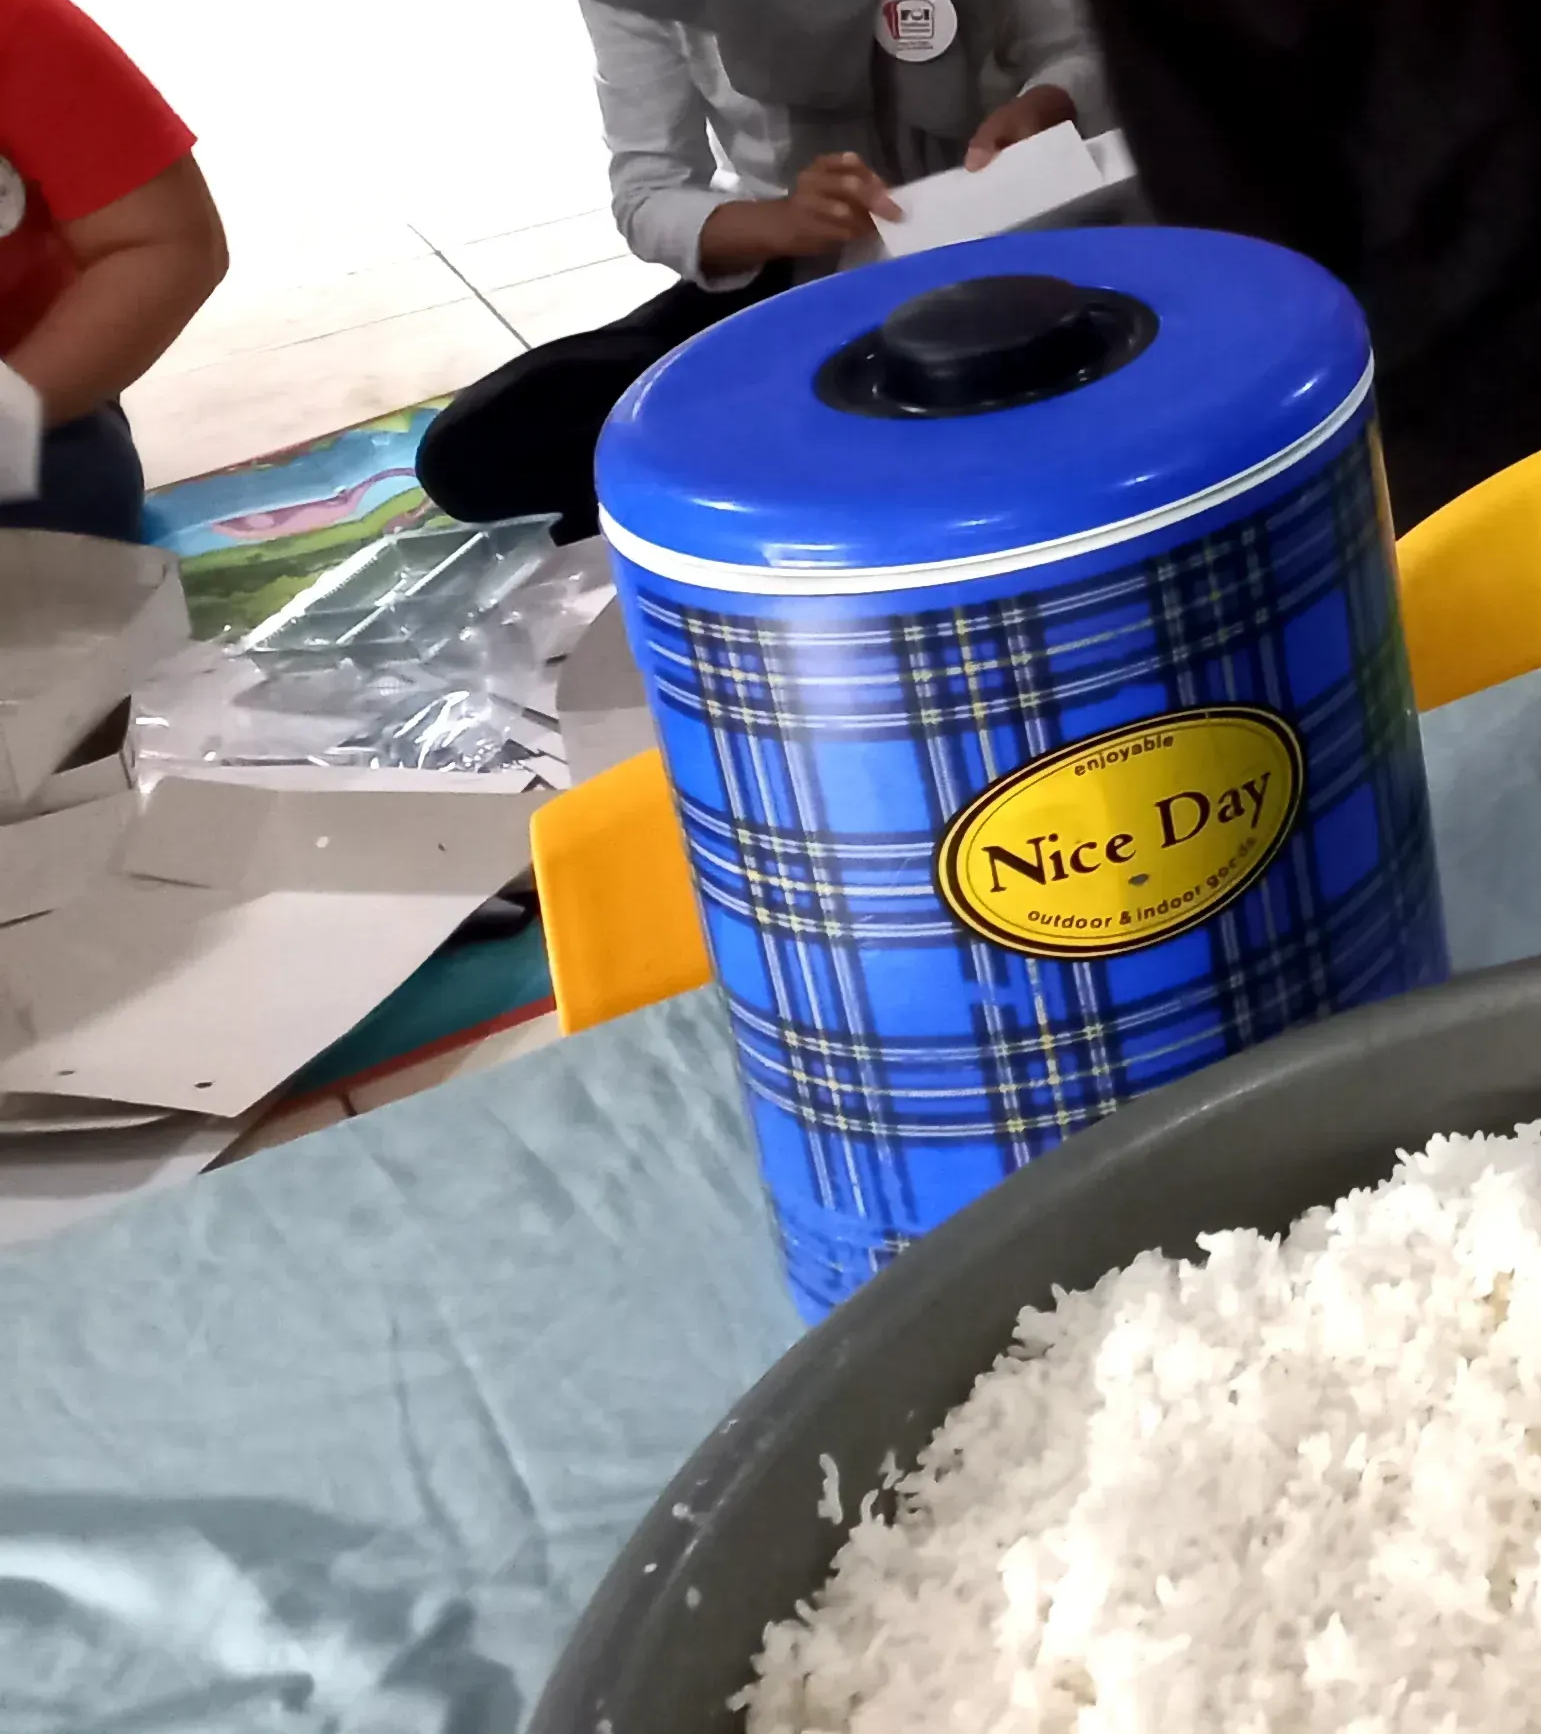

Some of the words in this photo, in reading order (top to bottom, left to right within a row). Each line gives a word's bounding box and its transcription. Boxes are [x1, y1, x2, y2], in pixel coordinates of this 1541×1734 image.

[1074, 734, 1174, 777] enjoyable
[982, 832, 1138, 894] Nice
[1154, 772, 1272, 850] Day
[1027, 910, 1112, 930] outdoor
[1119, 911, 1132, 926] &
[1136, 884, 1202, 922] indoor
